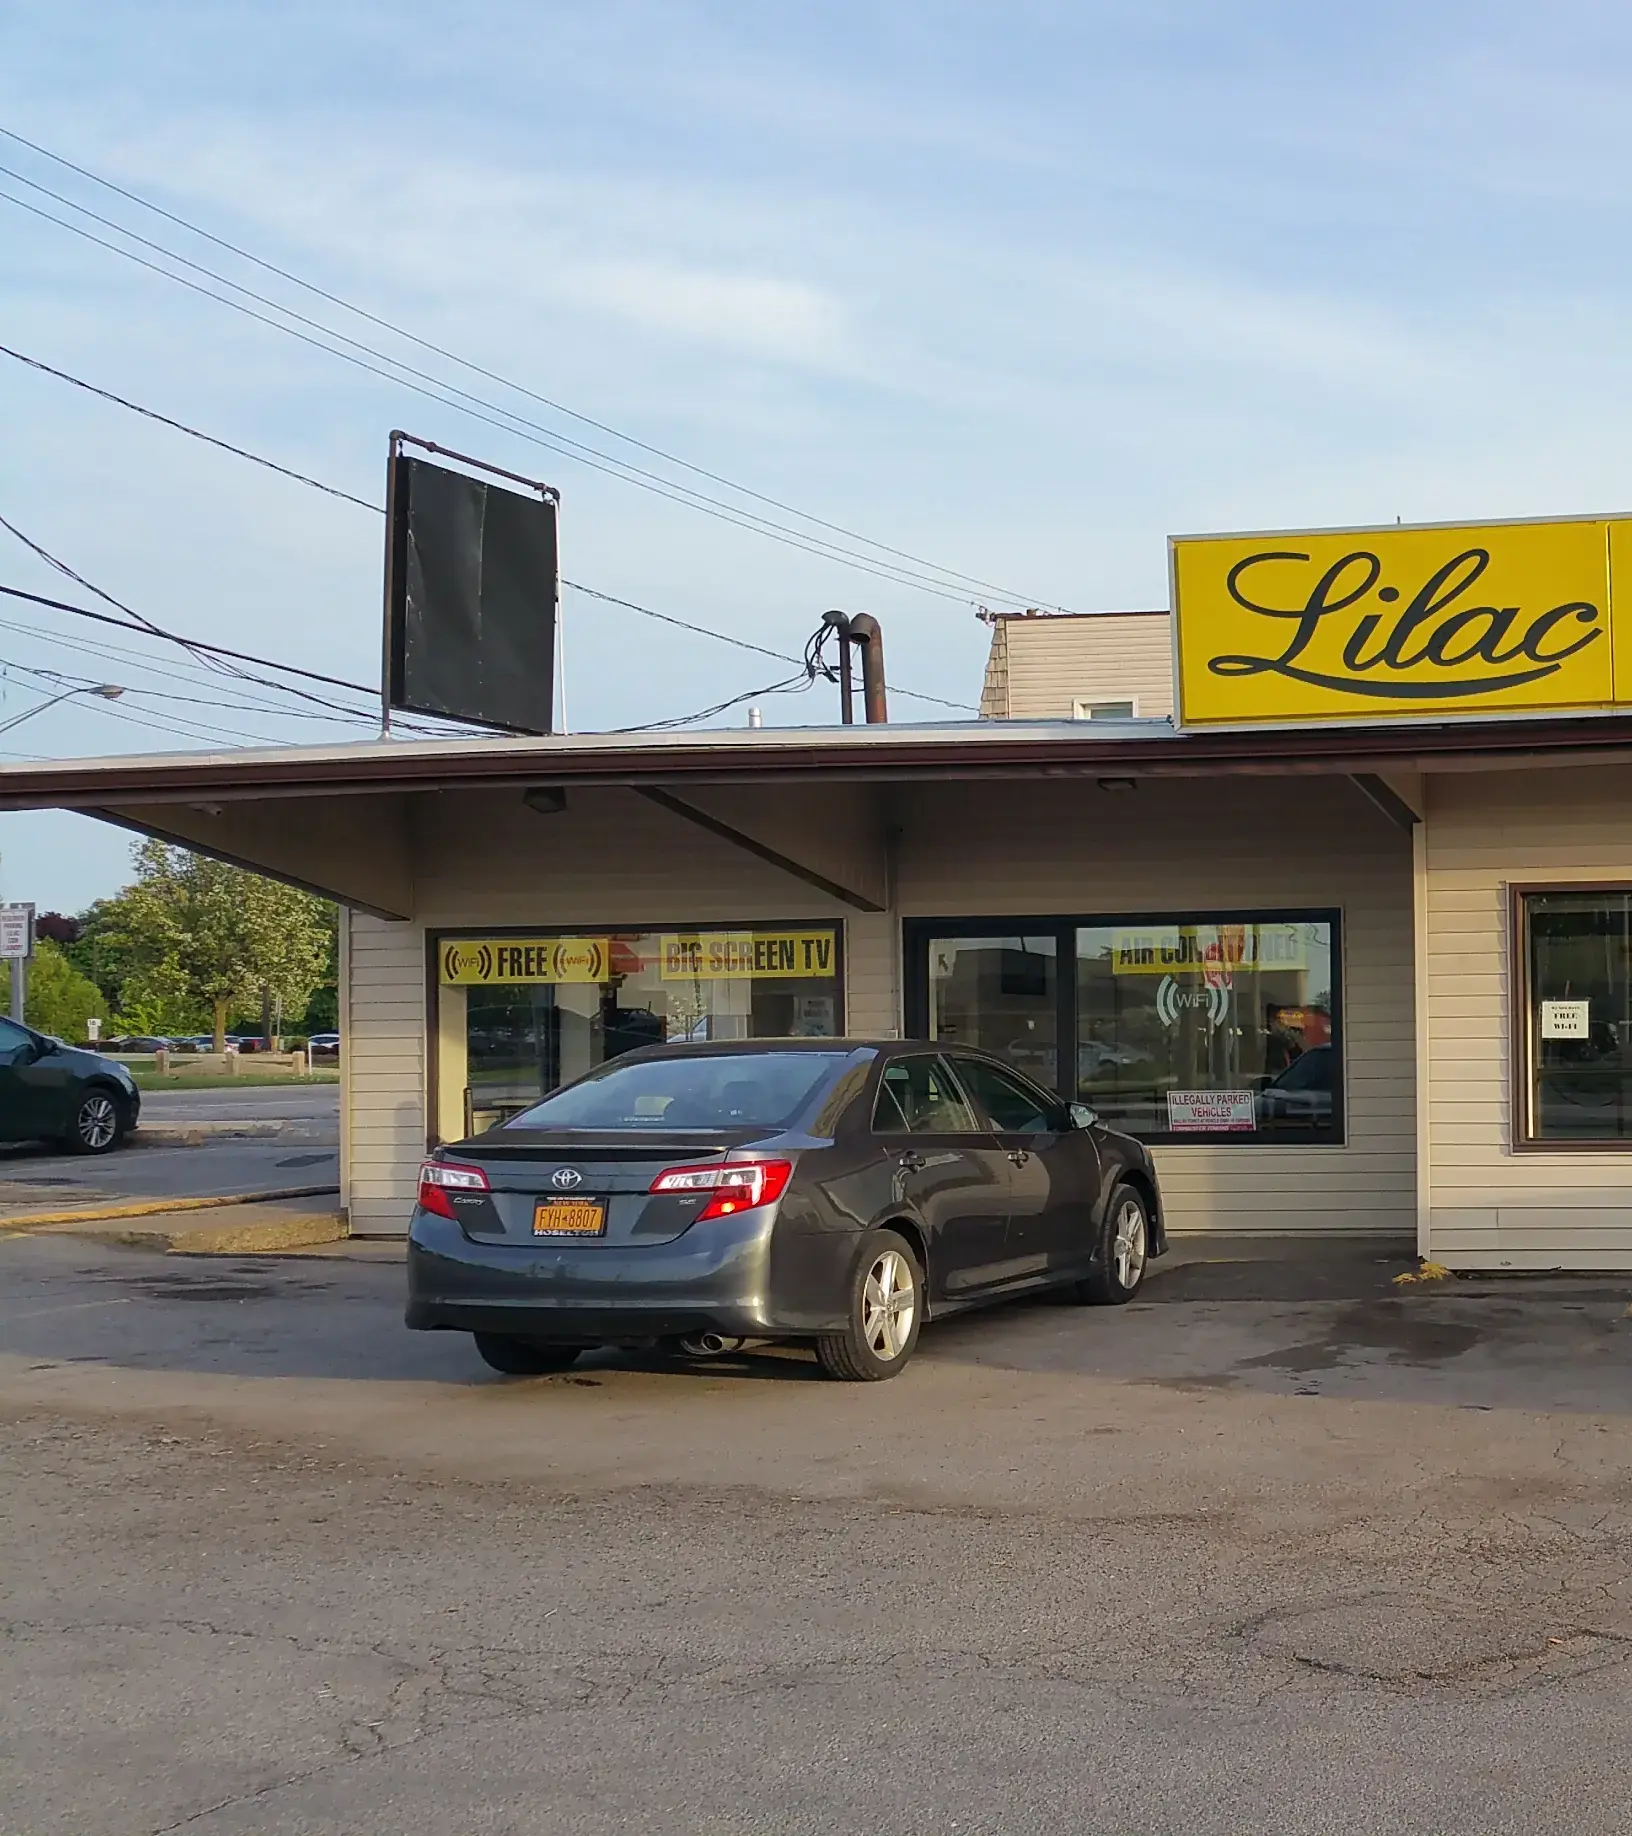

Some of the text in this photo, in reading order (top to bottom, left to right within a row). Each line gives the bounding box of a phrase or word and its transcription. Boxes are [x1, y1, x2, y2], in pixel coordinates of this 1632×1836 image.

[1207, 548, 1604, 698] Lilac
[497, 946, 548, 978] FREE
[667, 938, 831, 973] BIG SCREEN TV
[1119, 936, 1156, 965] AIR
[1172, 1093, 1250, 1105] ILLEGALLY PARKED
[1191, 1106, 1232, 1118] VEHICLES
